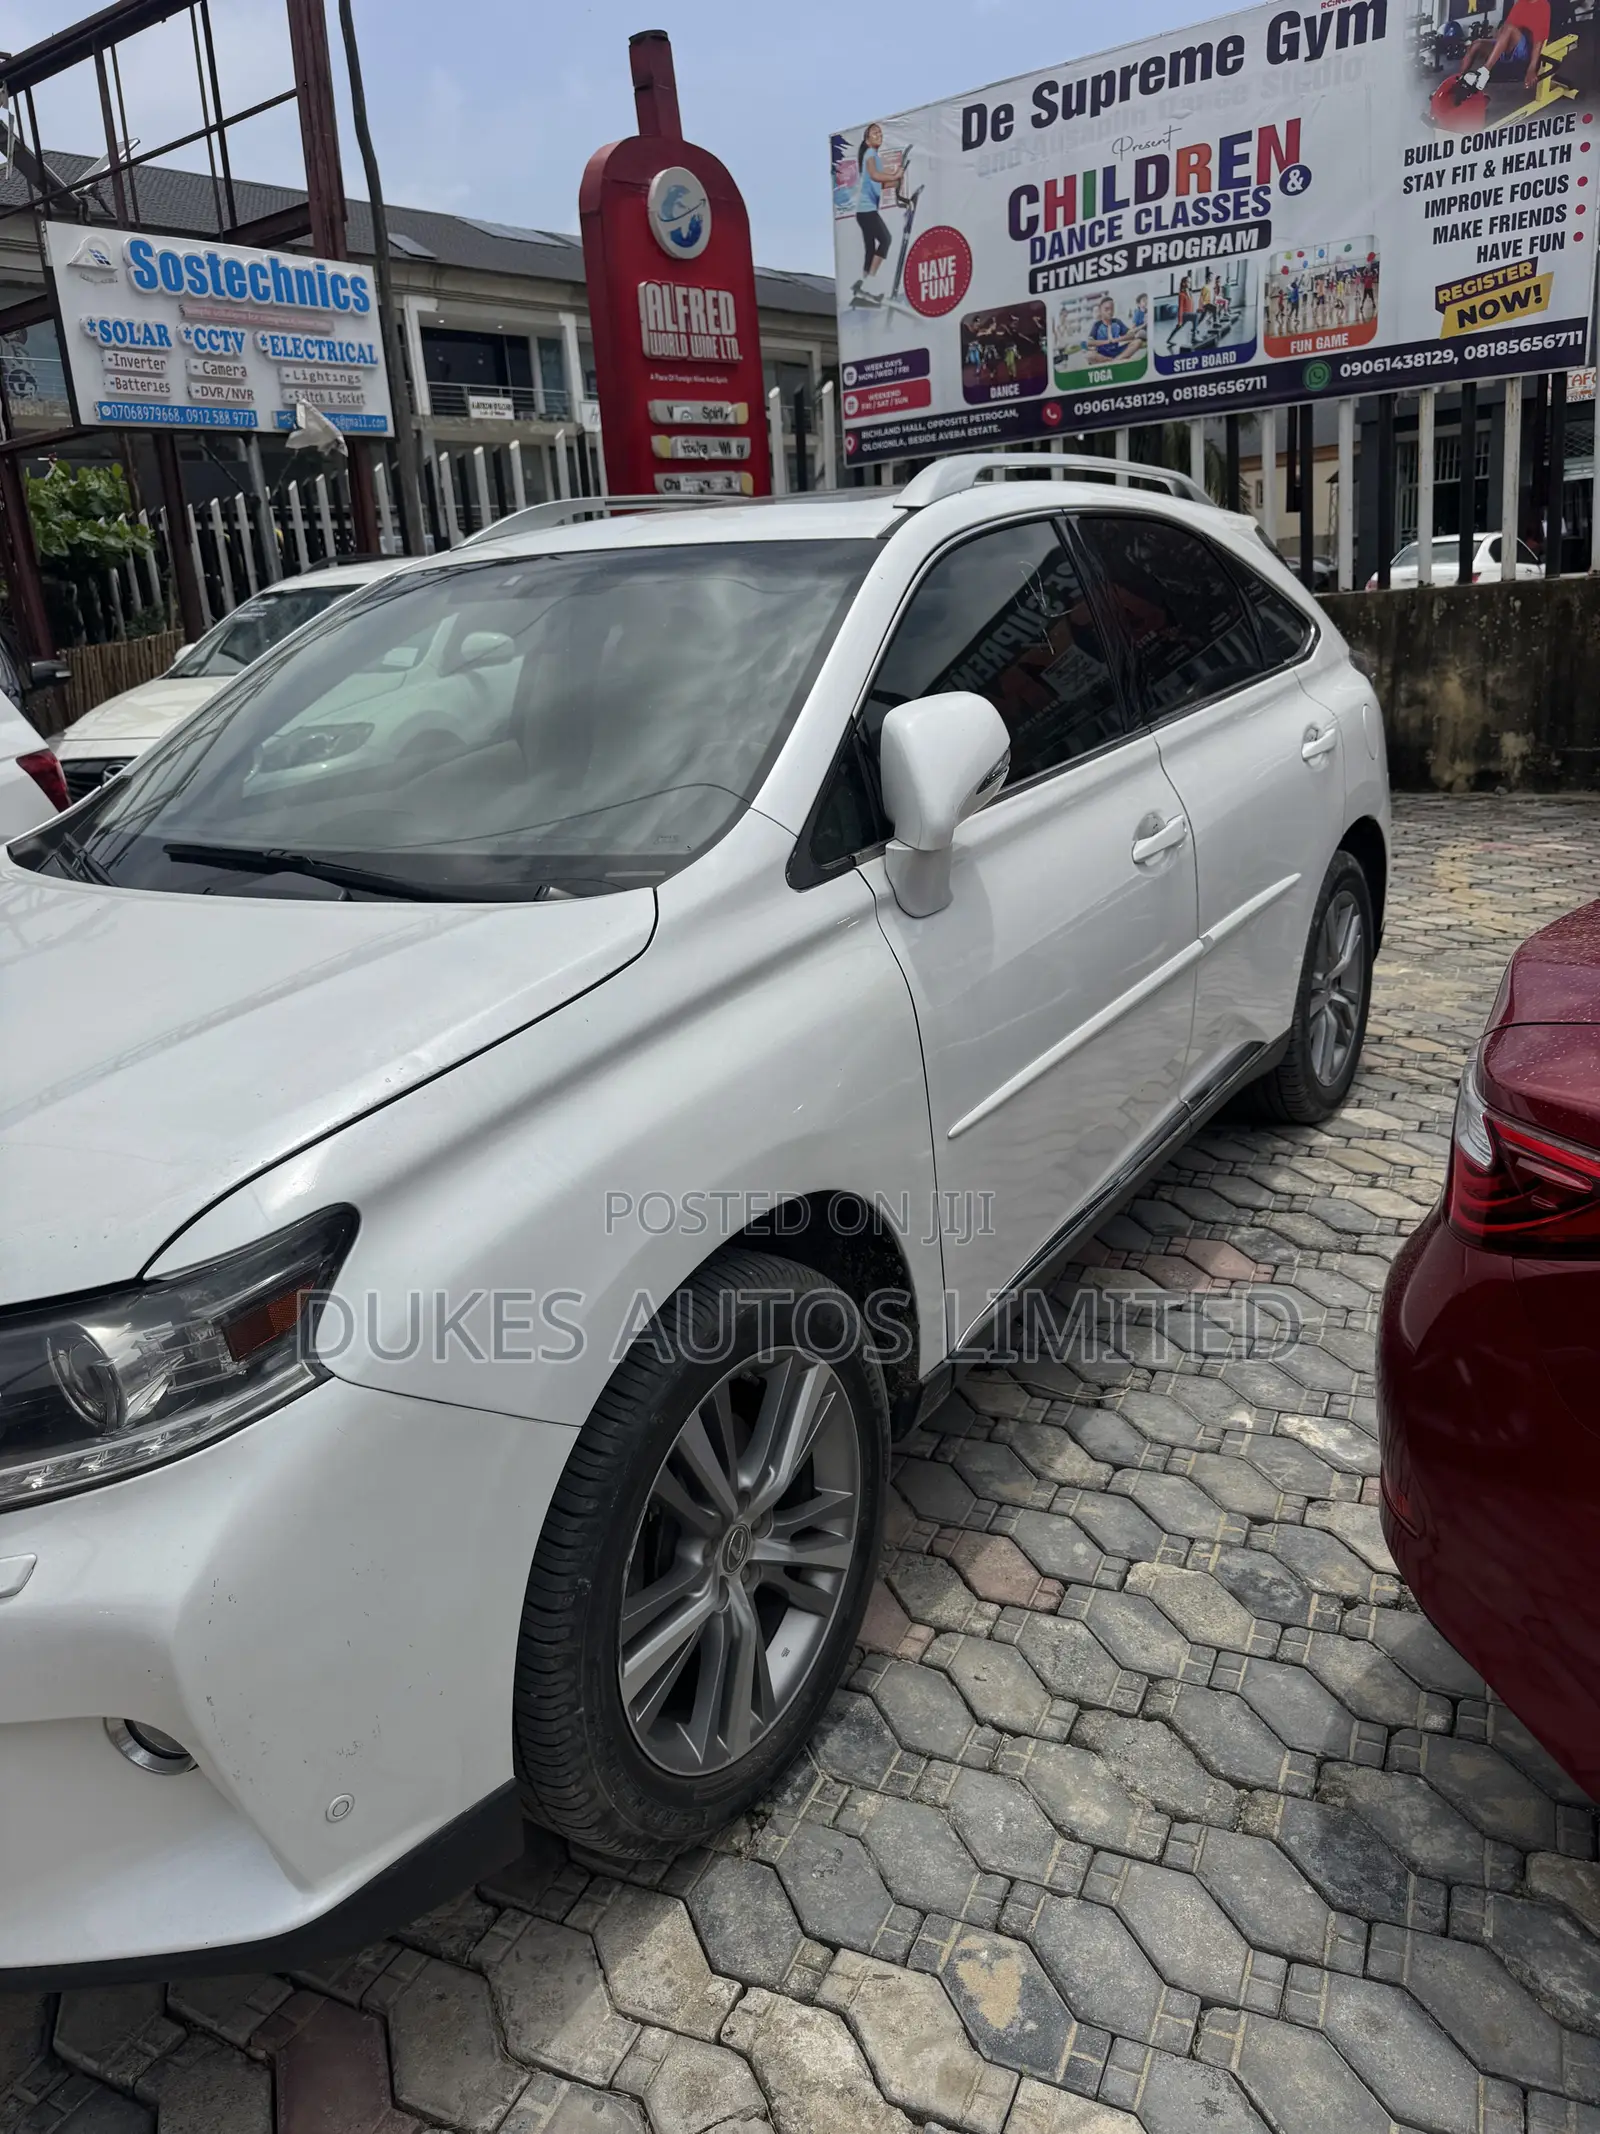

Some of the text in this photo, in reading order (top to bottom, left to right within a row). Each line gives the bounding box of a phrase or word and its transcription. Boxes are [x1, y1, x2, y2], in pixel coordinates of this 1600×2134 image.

[962, 103, 1014, 152] De
[1031, 34, 1244, 129] Supreme
[1265, 0, 1388, 65] Gym
[1112, 125, 1182, 161] Present
[1403, 113, 1577, 167] BUILD CONFIDENCE
[1008, 117, 1302, 242] CHILDREN
[1403, 143, 1572, 195] STAY FIT & HEALTH
[1424, 174, 1569, 219] IMPROVE FOCUS
[1030, 168, 1304, 265] DANCE CLASSES &
[1432, 203, 1567, 245] MAKE FRIENDS
[1037, 228, 1259, 293] FITNESS PROGRAM
[1476, 231, 1566, 263] HAVE FUN
[128, 238, 372, 314] Sostechnics
[918, 255, 957, 283] HAVE
[1438, 261, 1533, 304] REGISTER
[921, 275, 955, 302] FUN!
[1456, 284, 1543, 329] NOW!
[645, 282, 737, 336] ALFRED
[649, 332, 743, 361] WORLD WINE LTD.
[1173, 350, 1237, 373] STEP BOARD
[1290, 332, 1349, 354] FUN GAME
[1340, 330, 1583, 378] 09061438129, 08185656711
[202, 361, 248, 378] Camera
[293, 369, 361, 385] Lightings
[1088, 367, 1113, 384] YOGA
[989, 383, 1021, 399] DANCE
[1074, 375, 1268, 416] 09061438129, 08185656711
[186, 408, 211, 424] 0912
[213, 410, 231, 425] 588
[233, 411, 256, 427] 9773
[861, 425, 901, 440] RICHLAND
[927, 415, 968, 430] OPPOSITE
[908, 433, 937, 446] BESIDE
